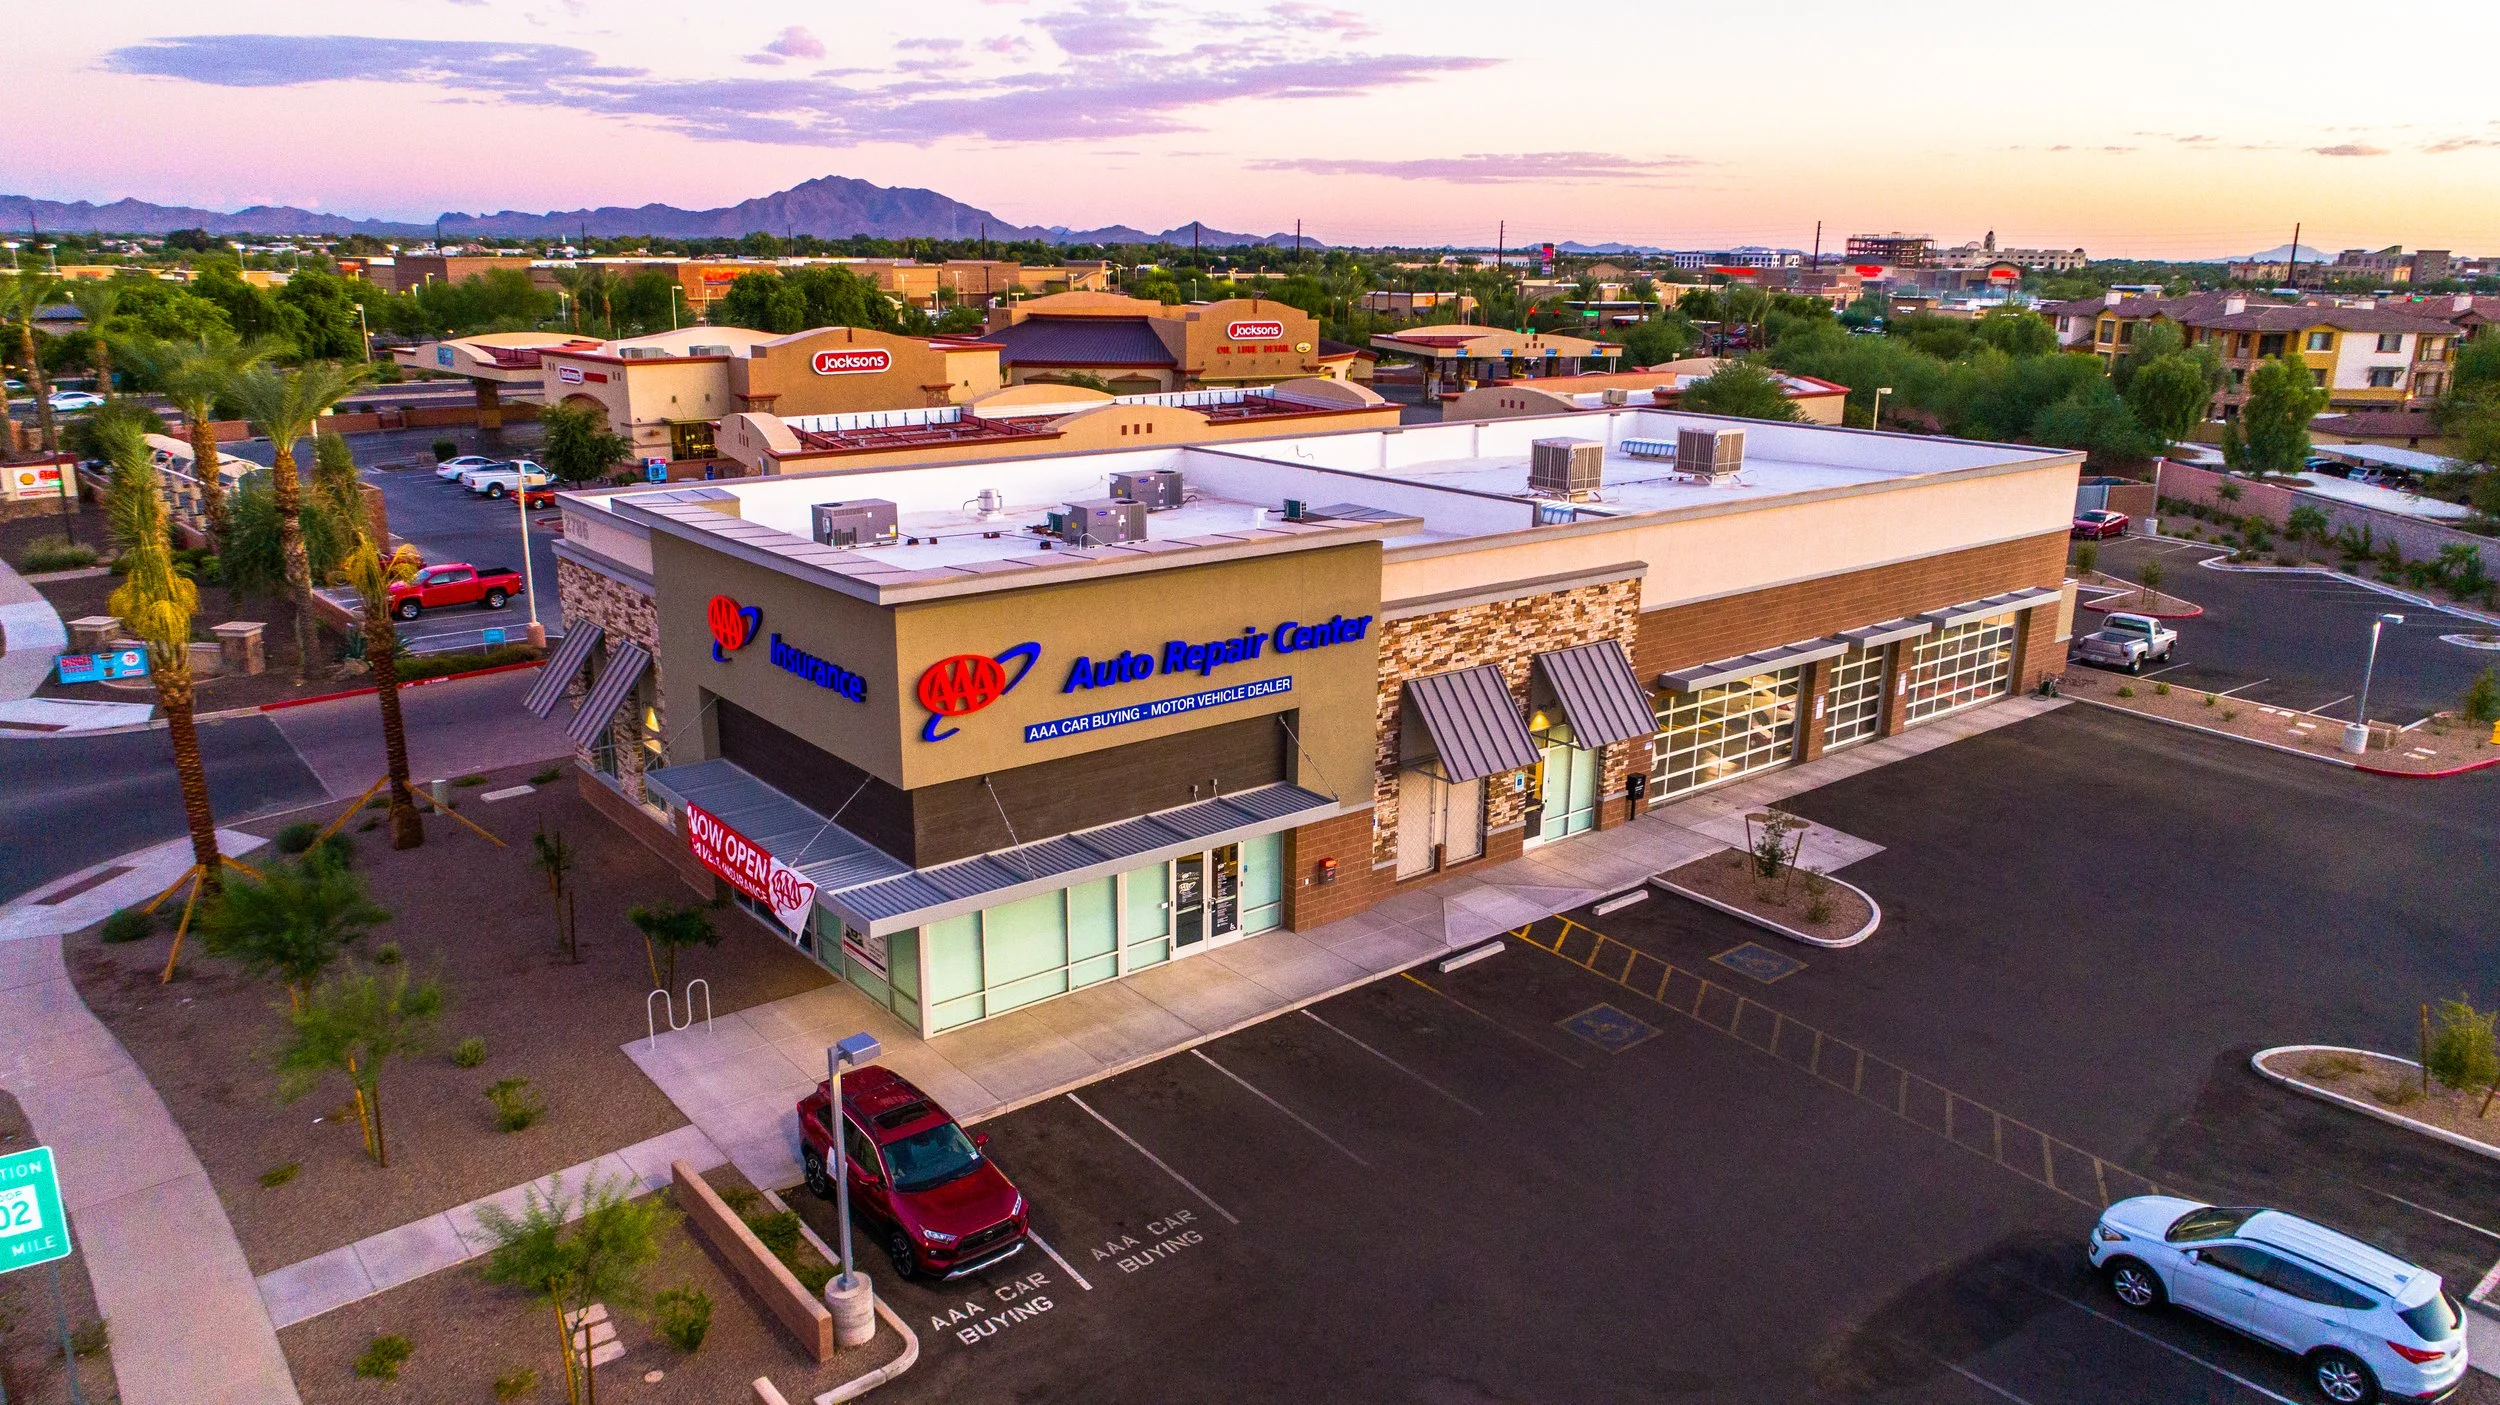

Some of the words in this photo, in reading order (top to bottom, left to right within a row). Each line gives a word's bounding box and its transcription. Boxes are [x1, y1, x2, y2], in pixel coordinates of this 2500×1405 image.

[1216, 346, 1231, 355] OIL
[1233, 325, 1279, 337] Jacksons
[821, 355, 885, 371] Jacksons
[709, 597, 742, 649] AAA
[770, 633, 867, 703] Insurance
[1062, 655, 1154, 693] Auto
[1162, 626, 1269, 675] Repair
[1273, 614, 1373, 655] Center
[927, 655, 997, 714] AAA
[1029, 722, 1059, 741] AAA
[1061, 717, 1089, 733] CAR
[1091, 707, 1140, 728] BUYING
[1151, 697, 1195, 716] MOTOR
[1197, 687, 1245, 708] VEHICLE
[1248, 678, 1291, 698] DEALER
[687, 805, 724, 853] NOW
[725, 835, 767, 885] OPEN
[772, 870, 801, 909] AAA
[11, 1235, 57, 1257] MILE
[1090, 1235, 1140, 1261] AAA
[1147, 1209, 1198, 1236] CAR
[1116, 1230, 1204, 1274] BUYING
[930, 1301, 986, 1331] AAA
[995, 1272, 1051, 1302] CAR
[956, 1296, 1054, 1345] BUYING
